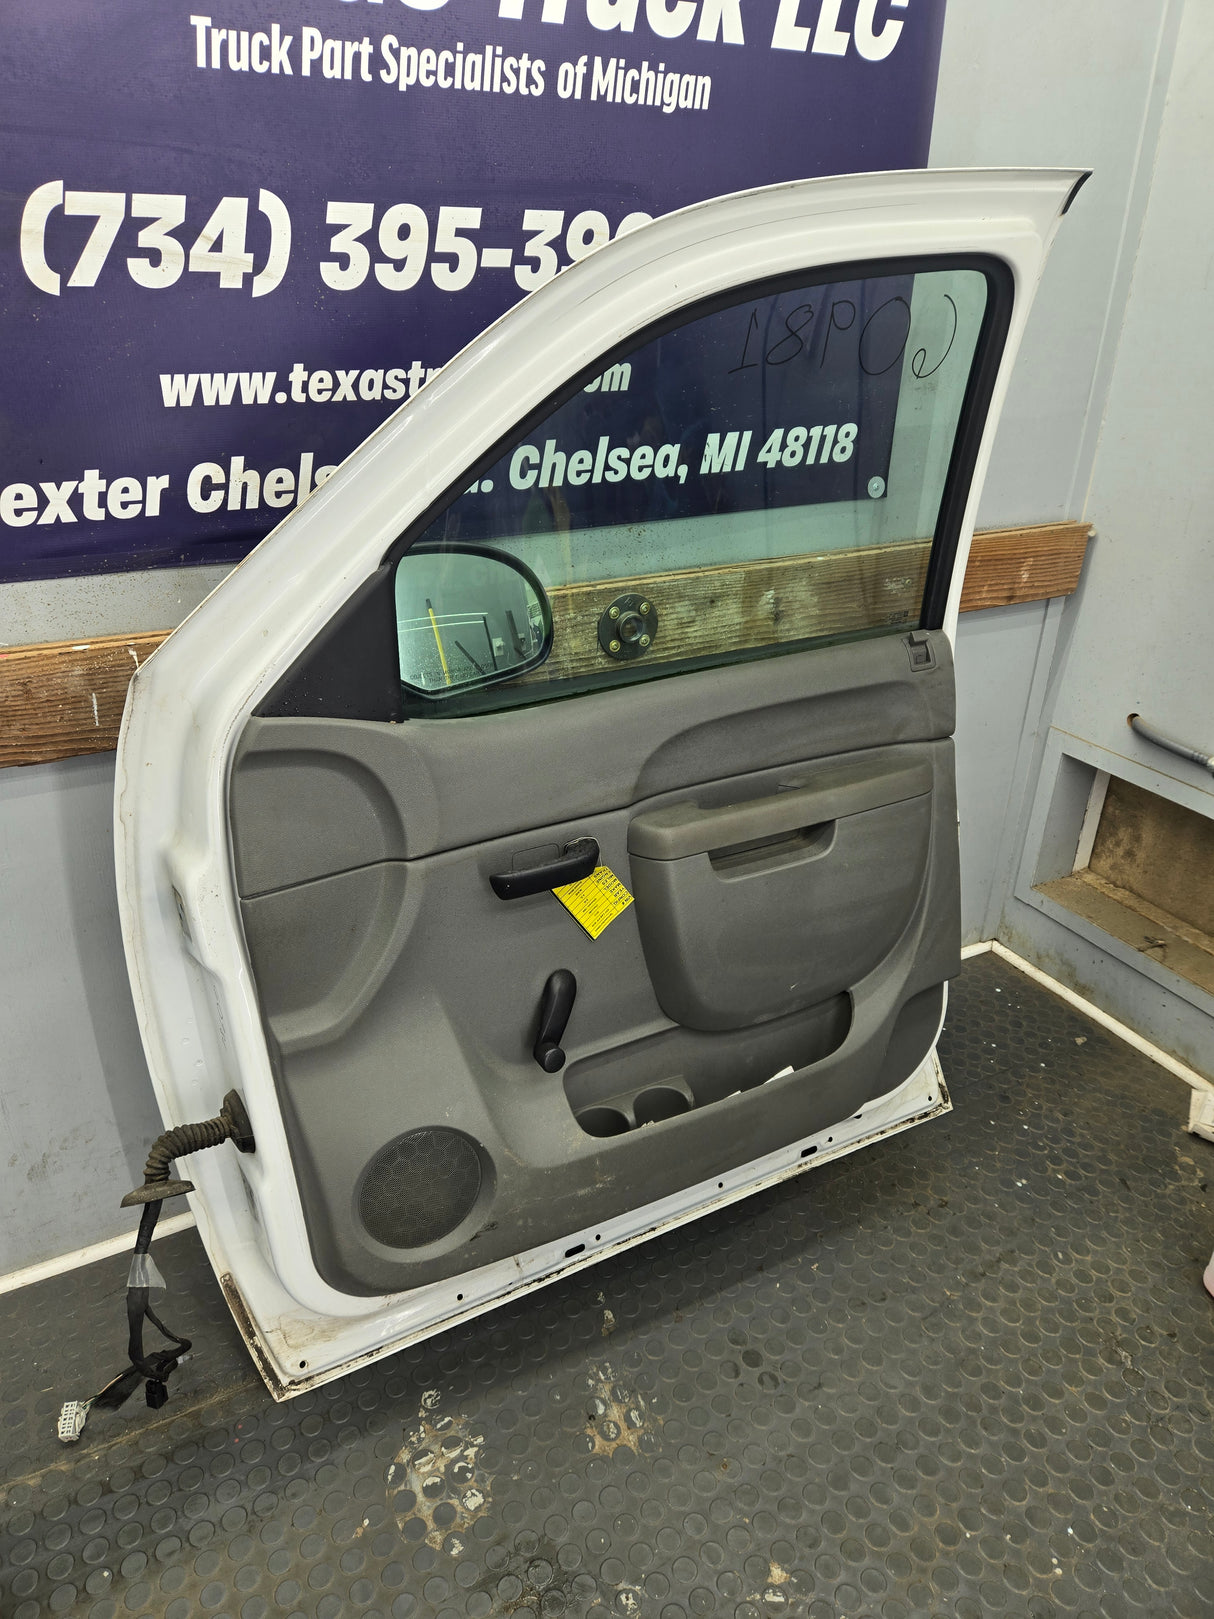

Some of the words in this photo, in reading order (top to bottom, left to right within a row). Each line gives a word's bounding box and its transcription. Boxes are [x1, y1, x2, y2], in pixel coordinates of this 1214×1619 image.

[190, 15, 294, 76] Truck
[301, 26, 374, 82] Part
[379, 34, 546, 97] Specialists
[556, 54, 589, 100] of
[590, 55, 712, 114] Michigan
[770, 0, 910, 62] LLC
[20, 180, 292, 298] (734)
[319, 201, 655, 292] 395-39
[508, 435, 689, 490] Chelsea,
[700, 430, 753, 475] MI
[757, 422, 859, 469] 48118
